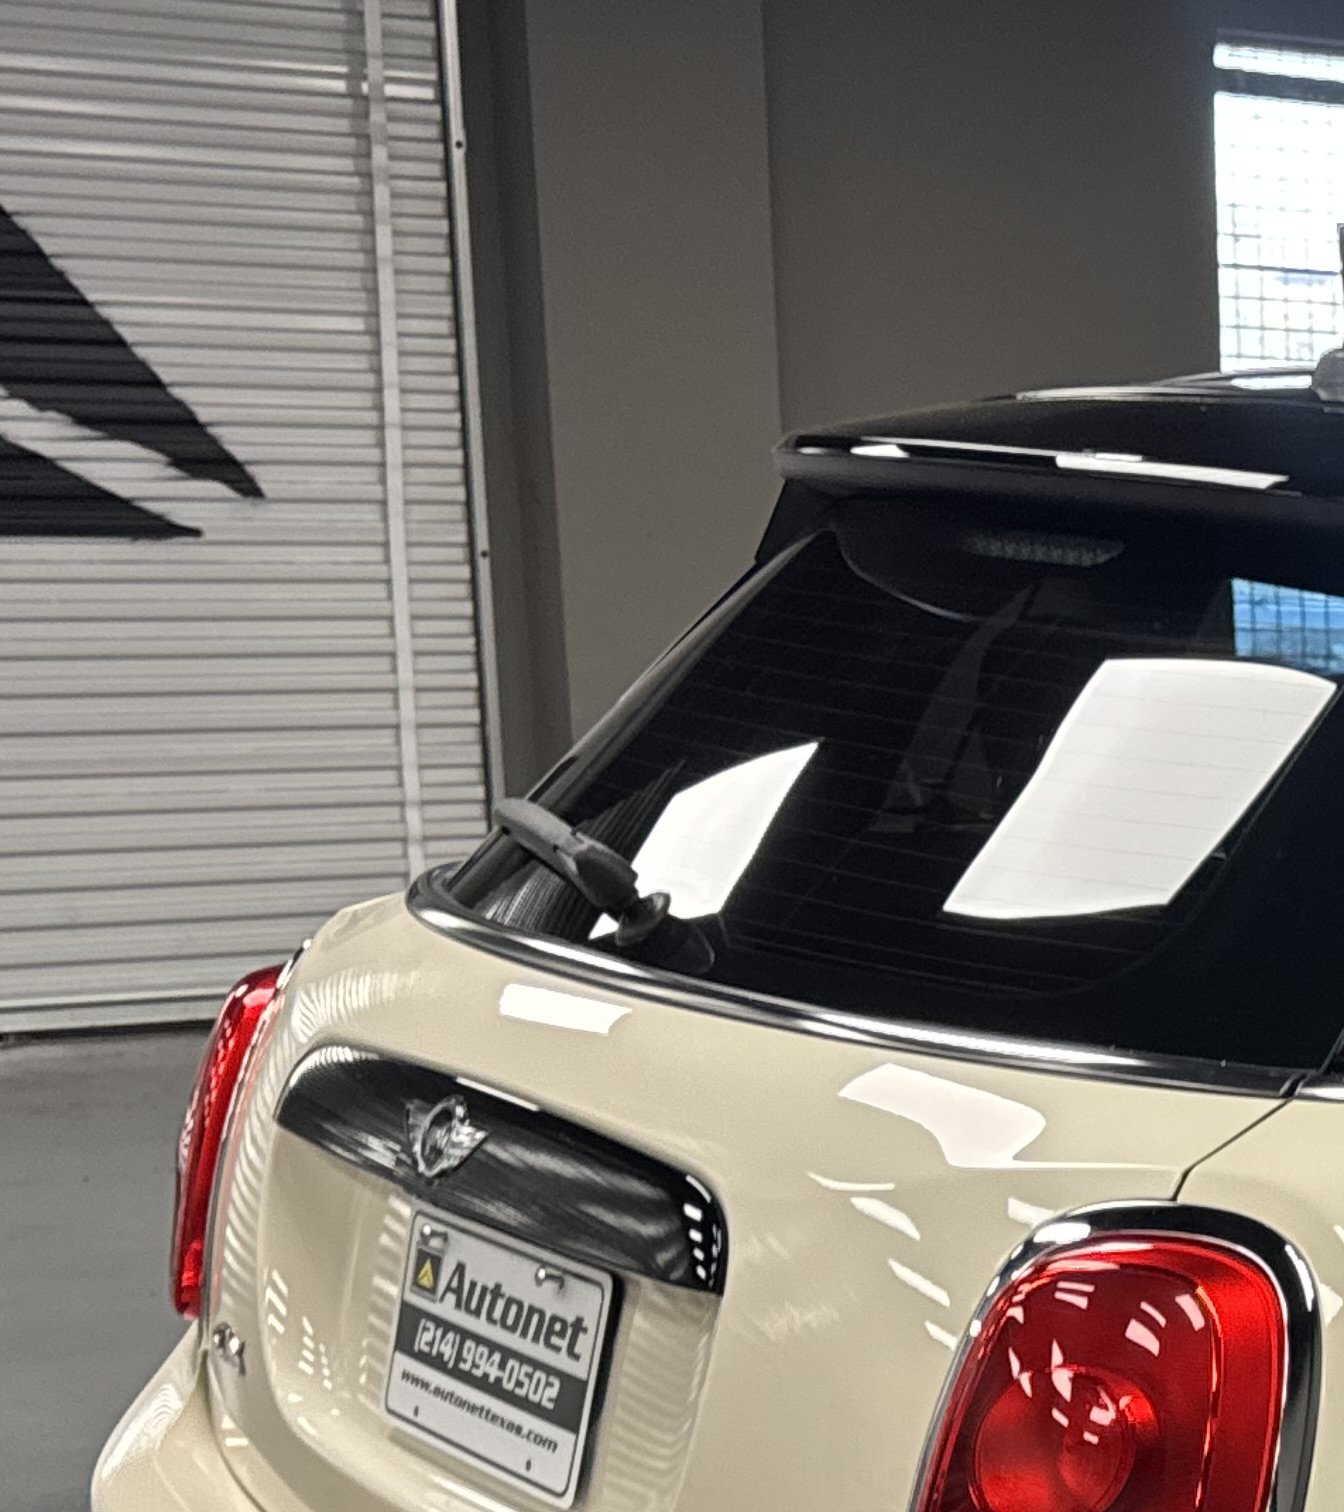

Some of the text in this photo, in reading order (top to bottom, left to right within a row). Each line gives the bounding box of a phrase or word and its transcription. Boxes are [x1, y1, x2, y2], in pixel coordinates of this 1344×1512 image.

[438, 1259, 589, 1363] Autonet
[400, 1367, 560, 1454] www.autonettexas.com
[414, 1318, 562, 1411] (214) 994-0502
